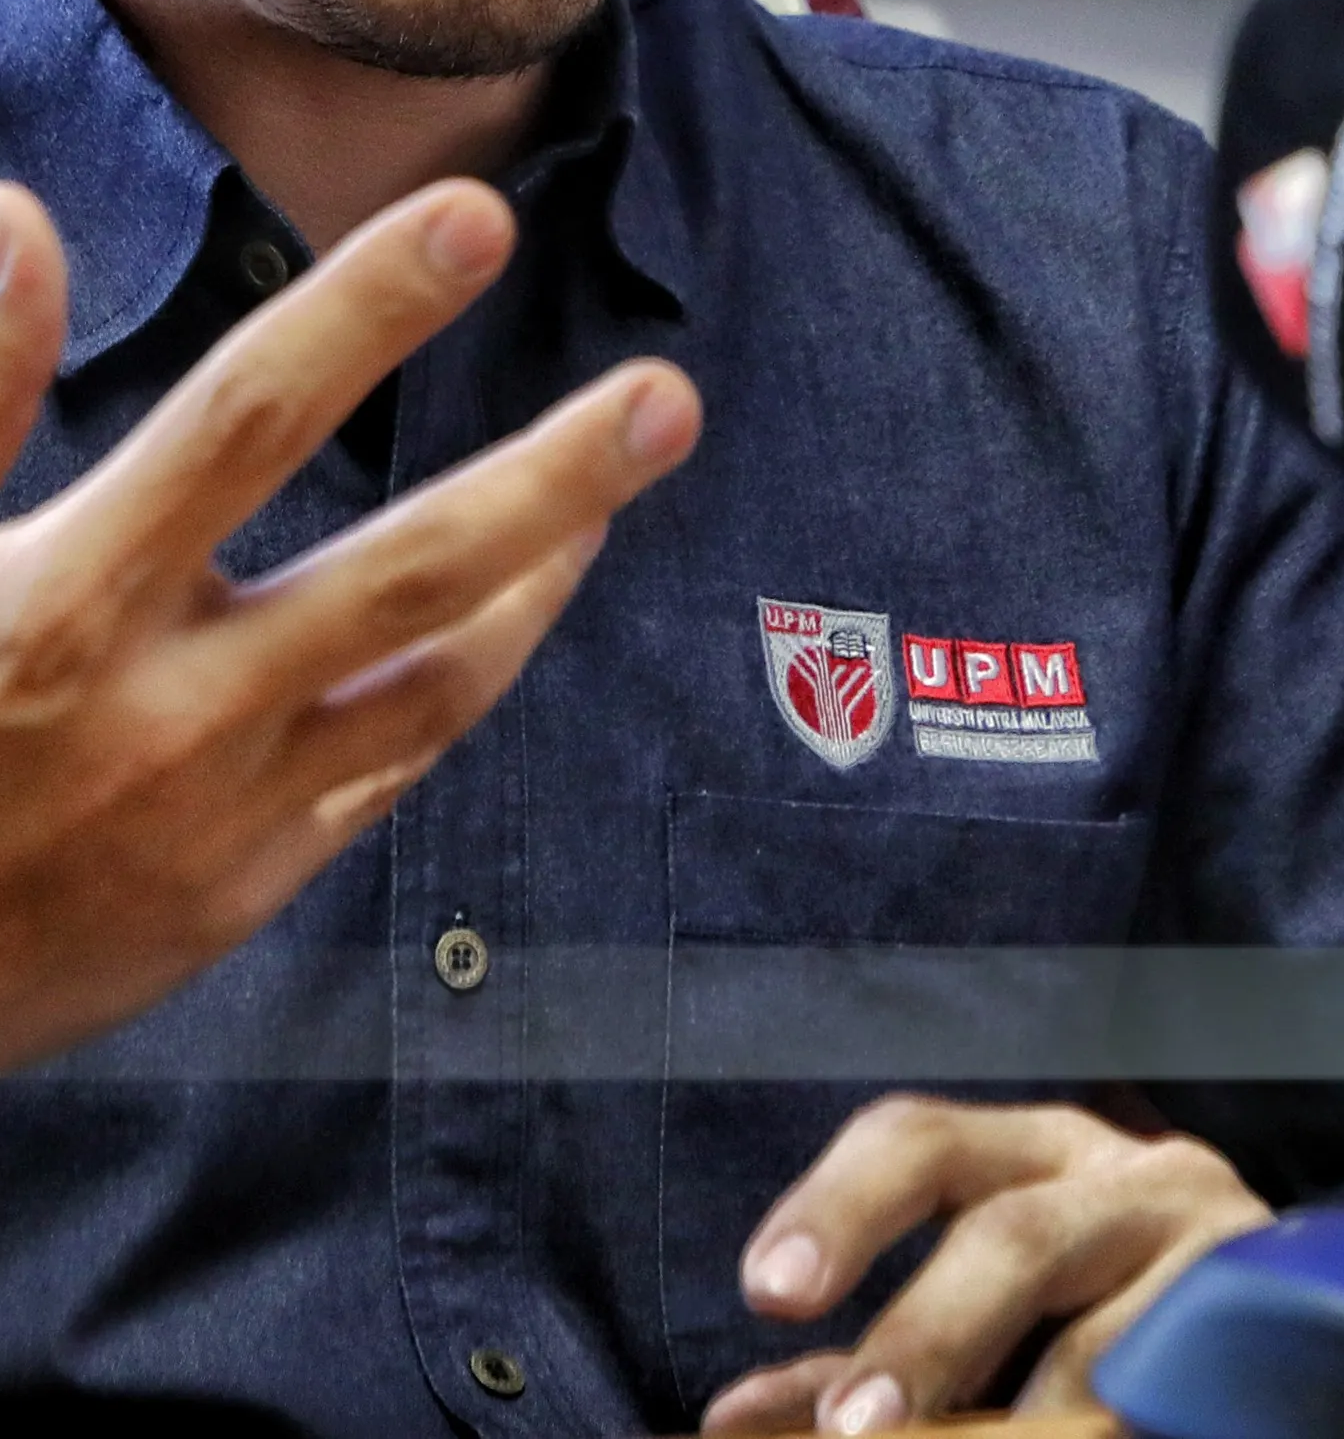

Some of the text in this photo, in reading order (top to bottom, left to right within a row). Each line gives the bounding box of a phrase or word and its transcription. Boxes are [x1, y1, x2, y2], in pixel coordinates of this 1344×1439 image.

[766, 605, 818, 632] UPM
[909, 643, 1070, 697] UPM
[909, 700, 1092, 731] UNIVERSITI PUTRA MALAYSIA
